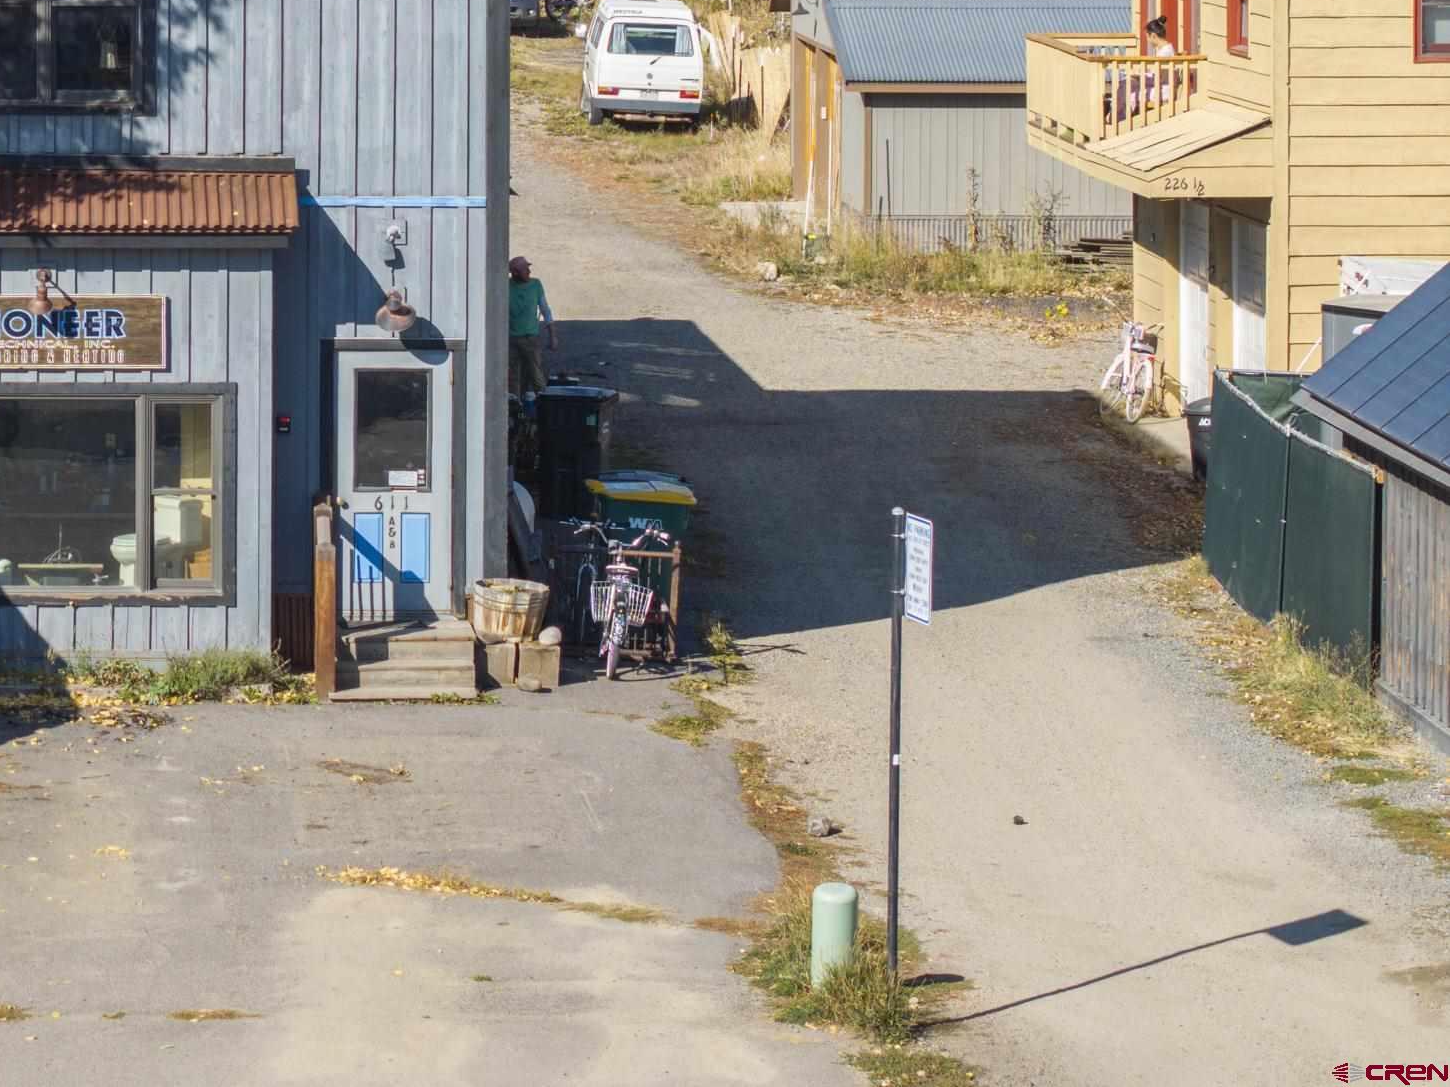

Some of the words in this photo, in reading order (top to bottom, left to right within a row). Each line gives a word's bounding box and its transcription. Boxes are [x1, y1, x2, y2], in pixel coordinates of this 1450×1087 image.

[1165, 177, 1189, 191] 226
[85, 339, 116, 350] INC.
[373, 494, 409, 511] 611
[629, 516, 663, 530] WM
